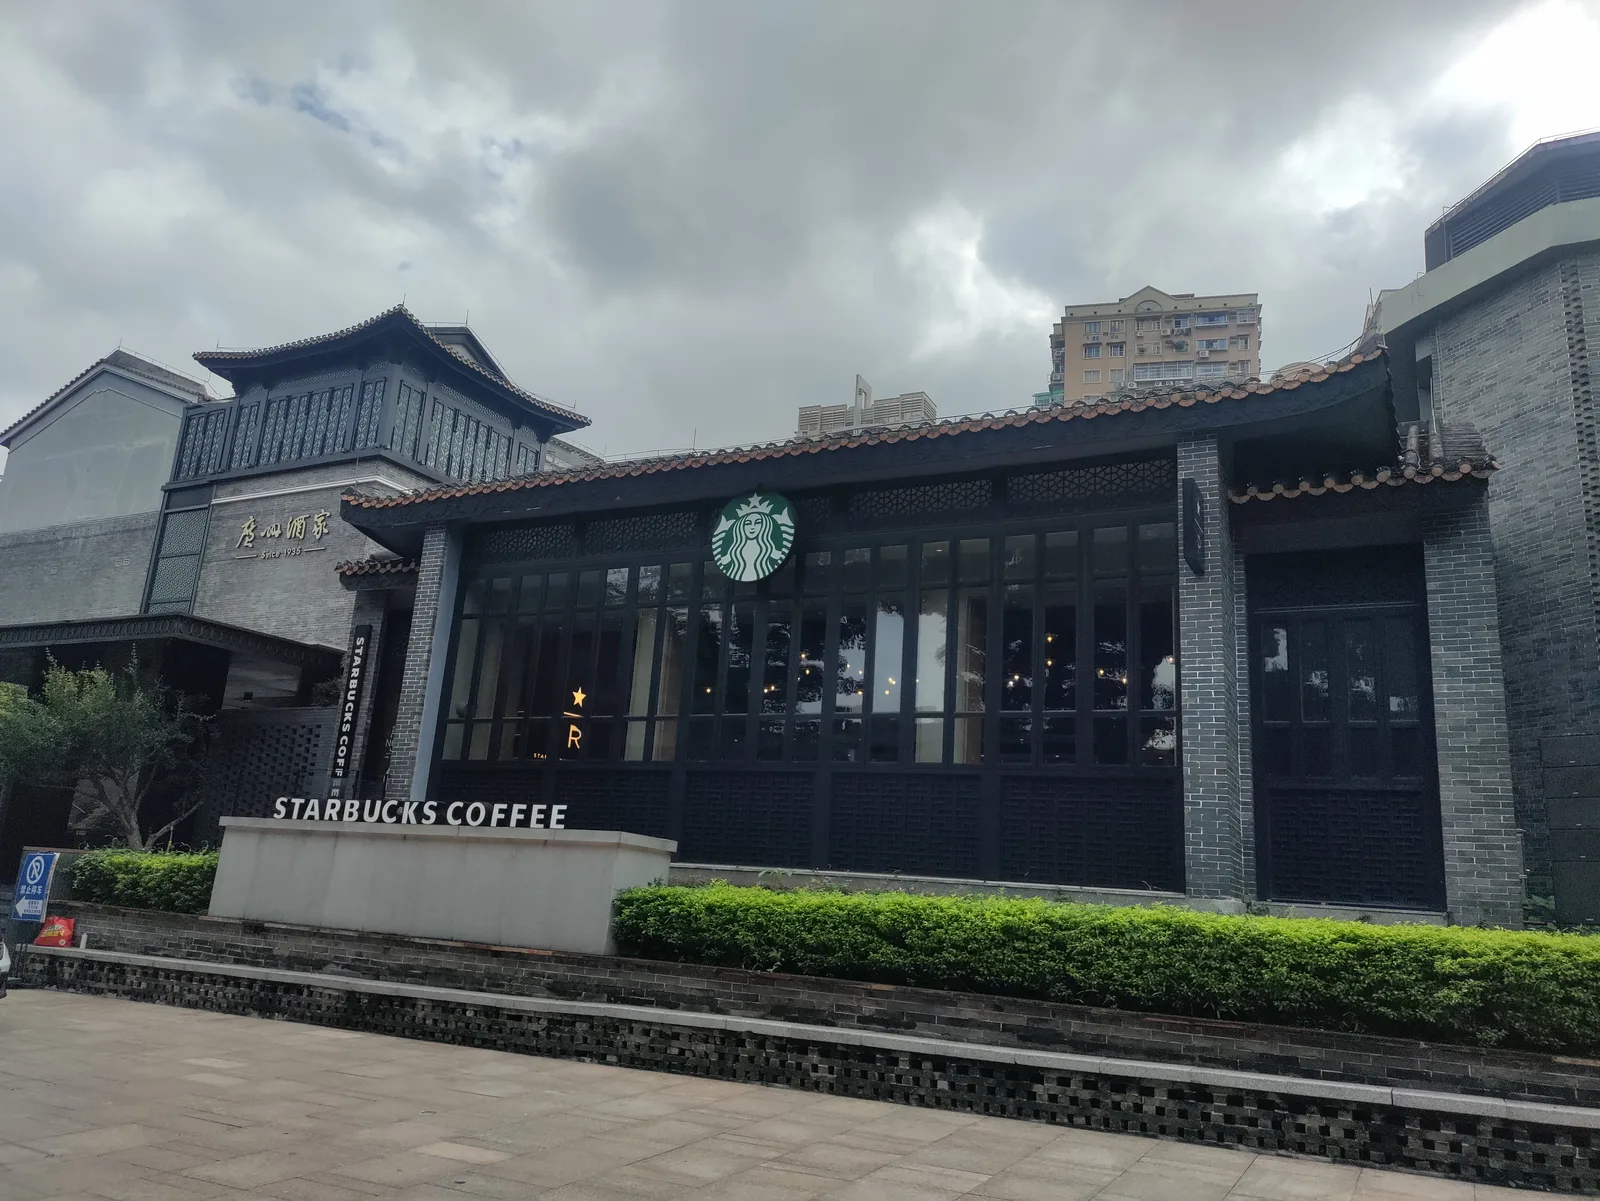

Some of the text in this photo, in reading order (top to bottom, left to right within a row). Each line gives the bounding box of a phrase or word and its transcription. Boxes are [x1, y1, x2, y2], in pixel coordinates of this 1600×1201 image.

[260, 548, 302, 560] Since 1935
[331, 637, 365, 797] STARBUCKS COFFEE
[567, 724, 582, 749] R
[273, 797, 568, 829] STARBUCKS COFFEE
